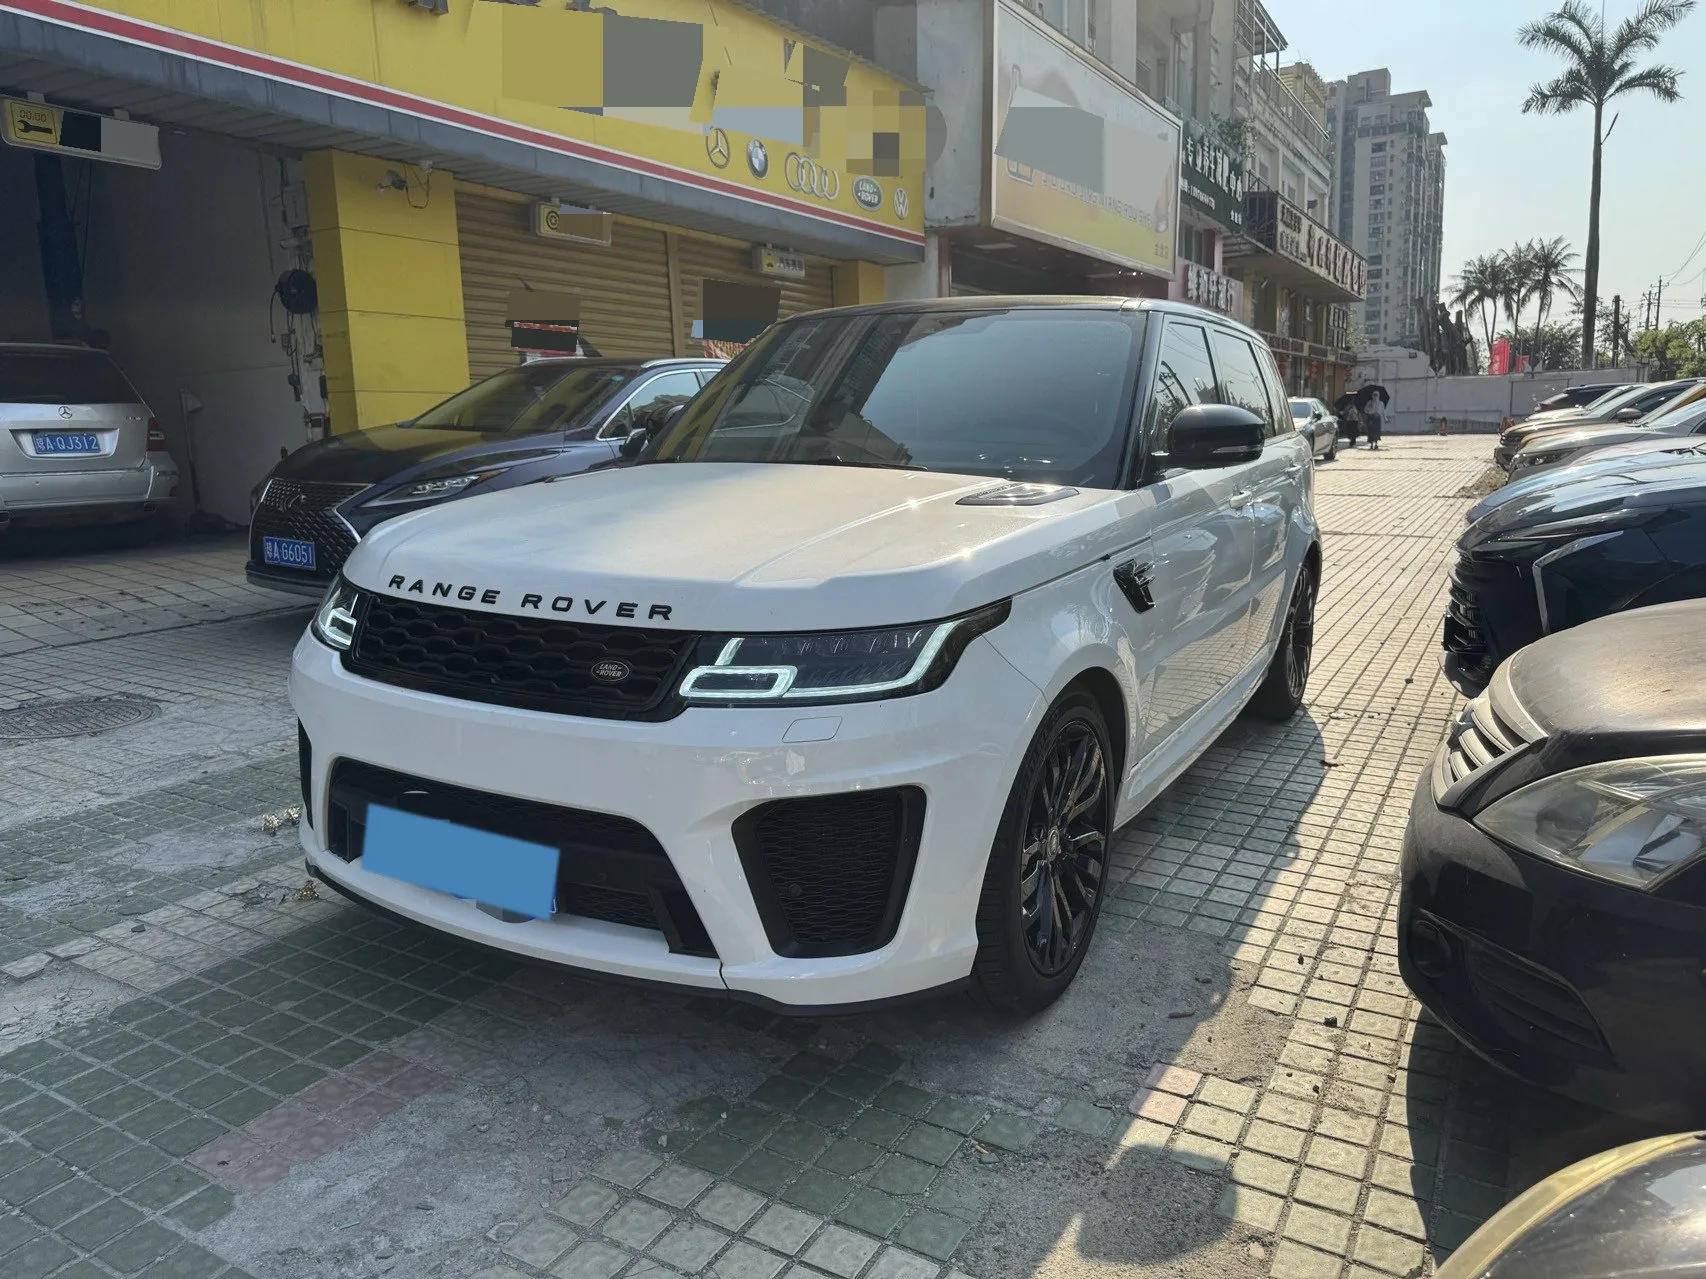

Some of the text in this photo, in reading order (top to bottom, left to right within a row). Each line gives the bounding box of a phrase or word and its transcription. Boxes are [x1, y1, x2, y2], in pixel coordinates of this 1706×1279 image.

[388, 574, 673, 621] RANGE ROVER
[599, 663, 618, 671] LAND
